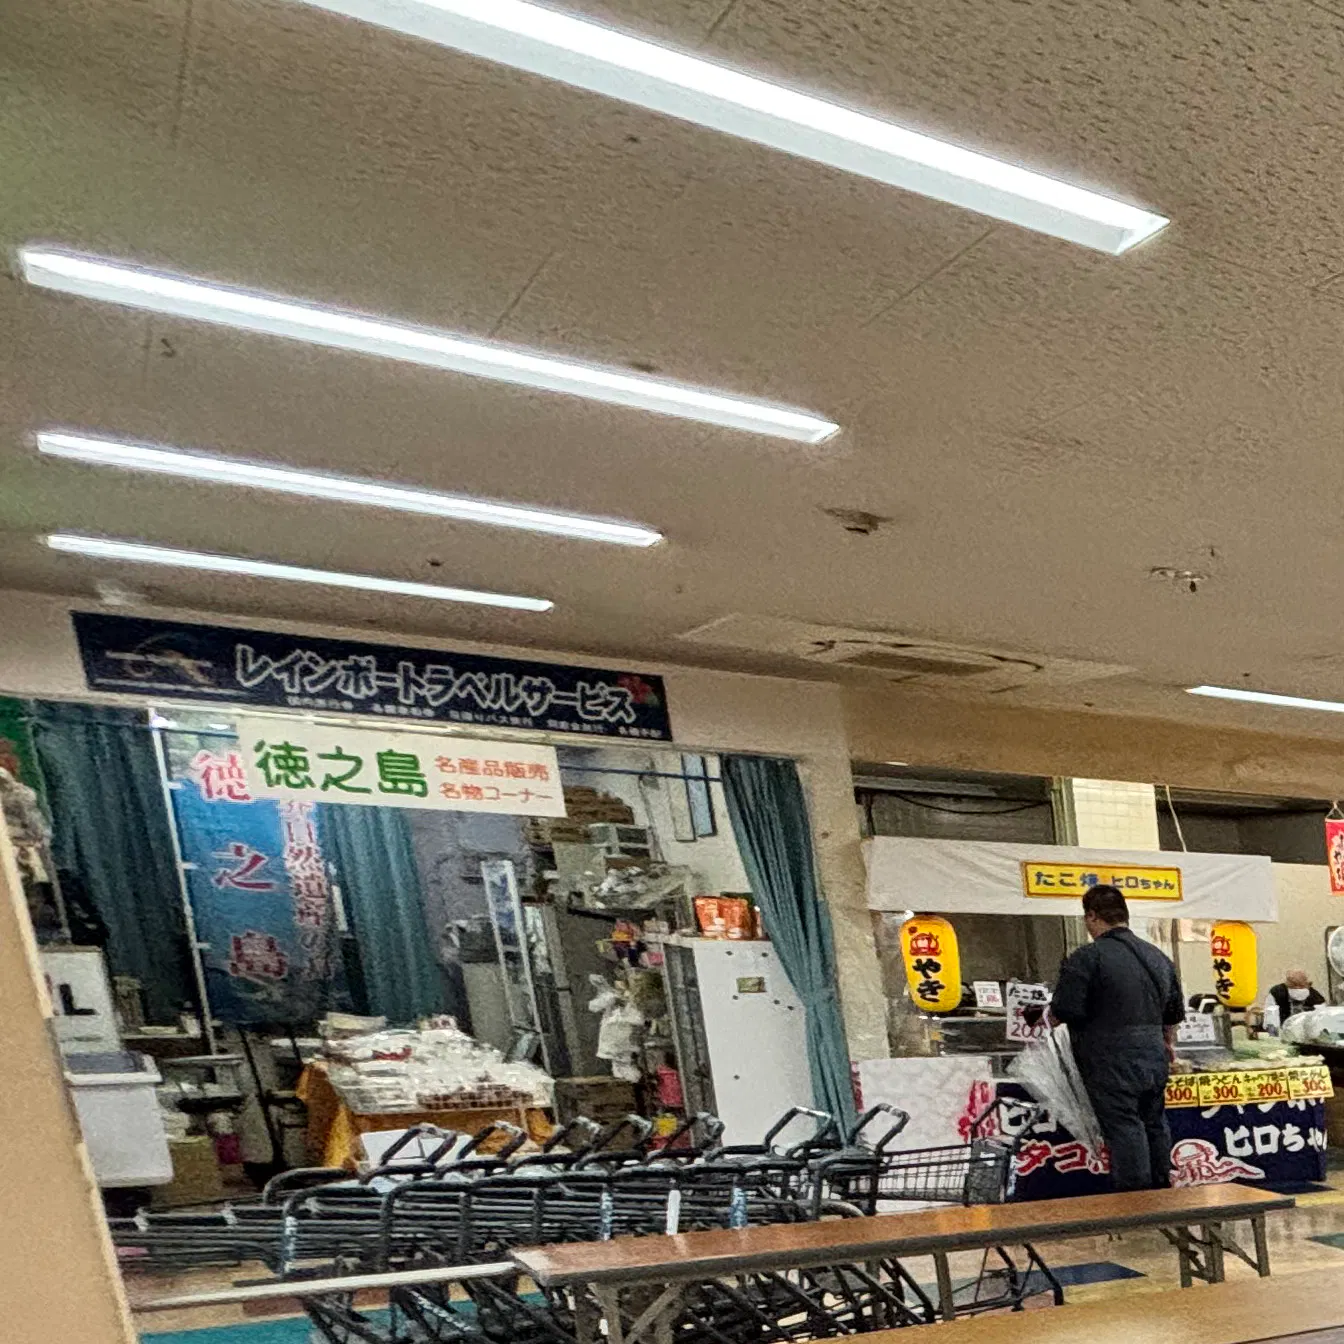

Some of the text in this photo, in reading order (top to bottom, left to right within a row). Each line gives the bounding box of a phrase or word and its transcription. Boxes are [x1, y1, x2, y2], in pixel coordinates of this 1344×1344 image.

[236, 644, 636, 723] レインボートラベルサービス
[254, 740, 428, 798] 徳之島
[434, 755, 549, 781] 名産品販売
[439, 781, 554, 802] 名物コーナー
[192, 750, 288, 978] 徳之島
[1111, 875, 1175, 891] ヒロちゃん
[912, 958, 945, 1002] やき
[1213, 958, 1235, 1000] やき
[1213, 1085, 1239, 1099] 300
[1258, 1083, 1283, 1097] 200
[1223, 1123, 1328, 1157] ヒロちゃ
